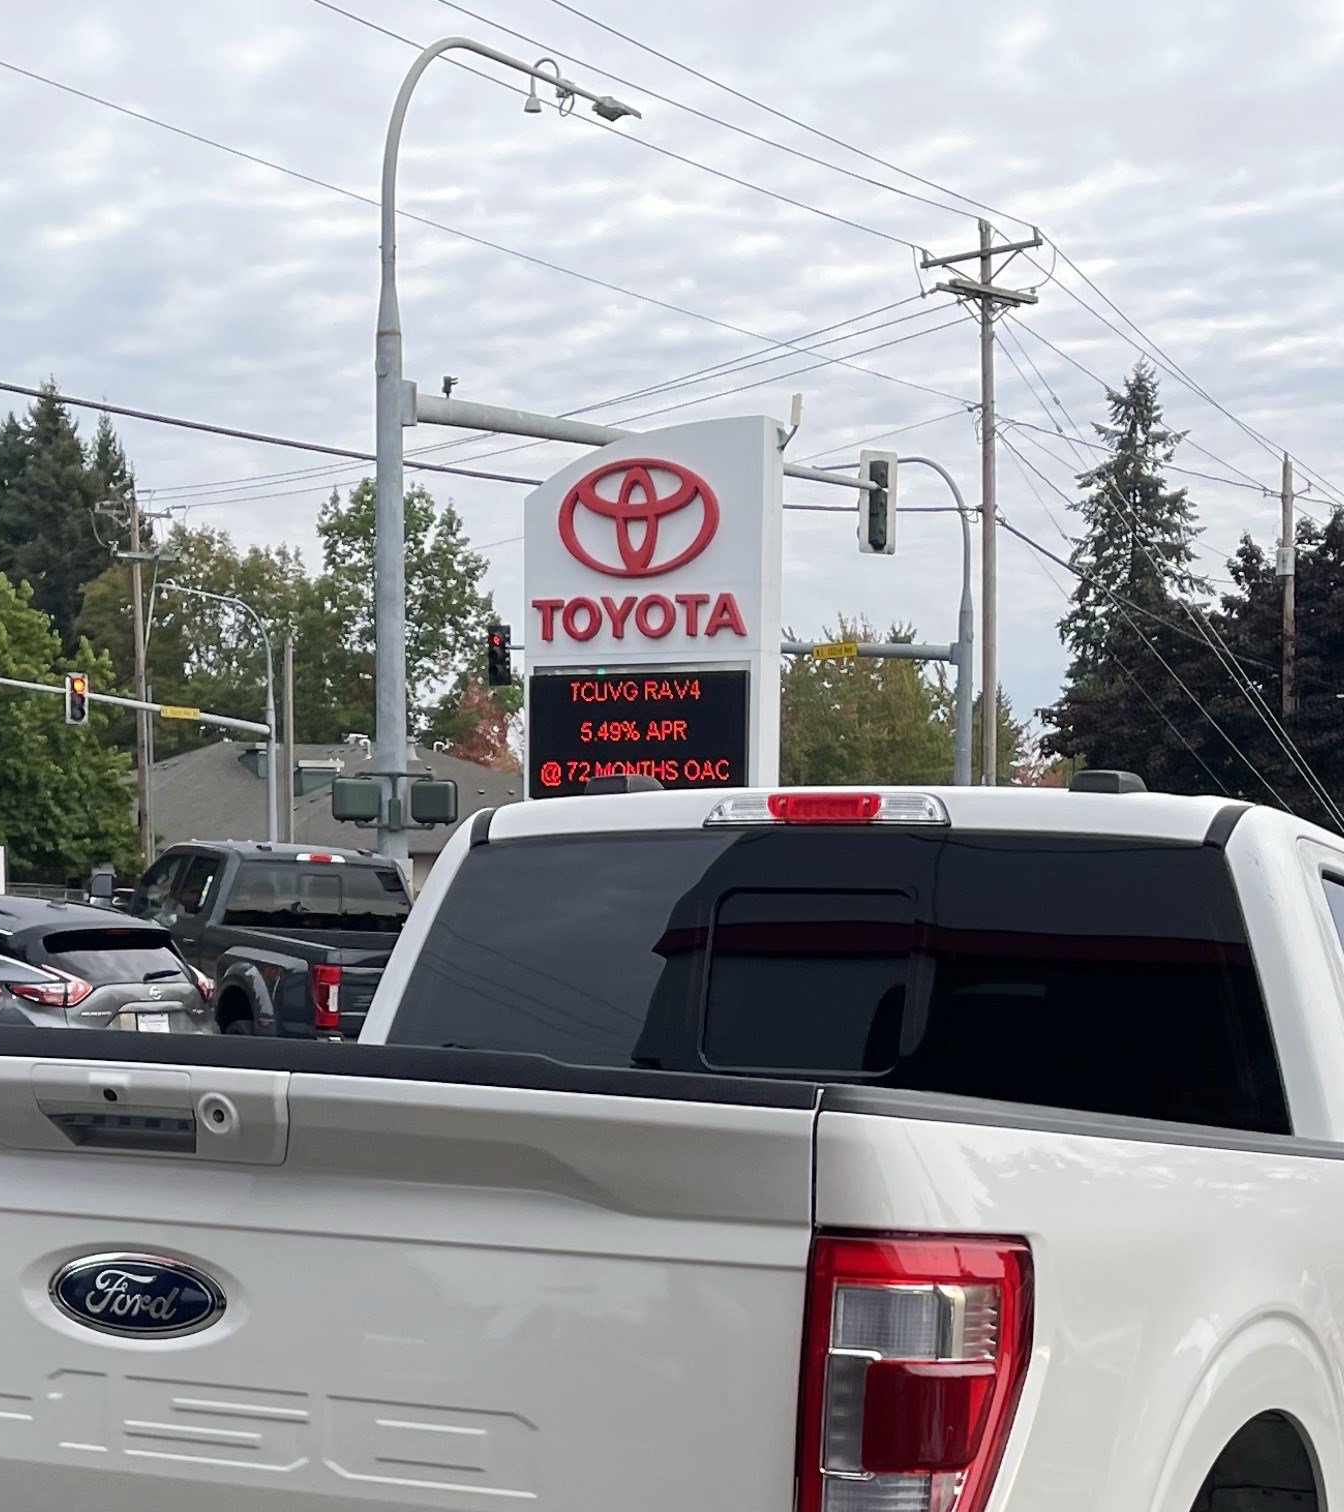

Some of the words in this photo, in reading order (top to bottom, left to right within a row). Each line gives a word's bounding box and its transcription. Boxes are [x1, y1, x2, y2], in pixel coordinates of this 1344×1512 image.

[532, 593, 748, 642] TOYOTA
[569, 679, 639, 702] TCUVG
[644, 678, 702, 701] RAV4
[580, 720, 641, 743] 5.49%
[645, 719, 688, 742] APR
[539, 760, 562, 787] @
[566, 761, 591, 782] 72
[594, 759, 680, 781] MONTHS
[683, 758, 731, 781] OAC
[85, 1269, 180, 1321] Ford
